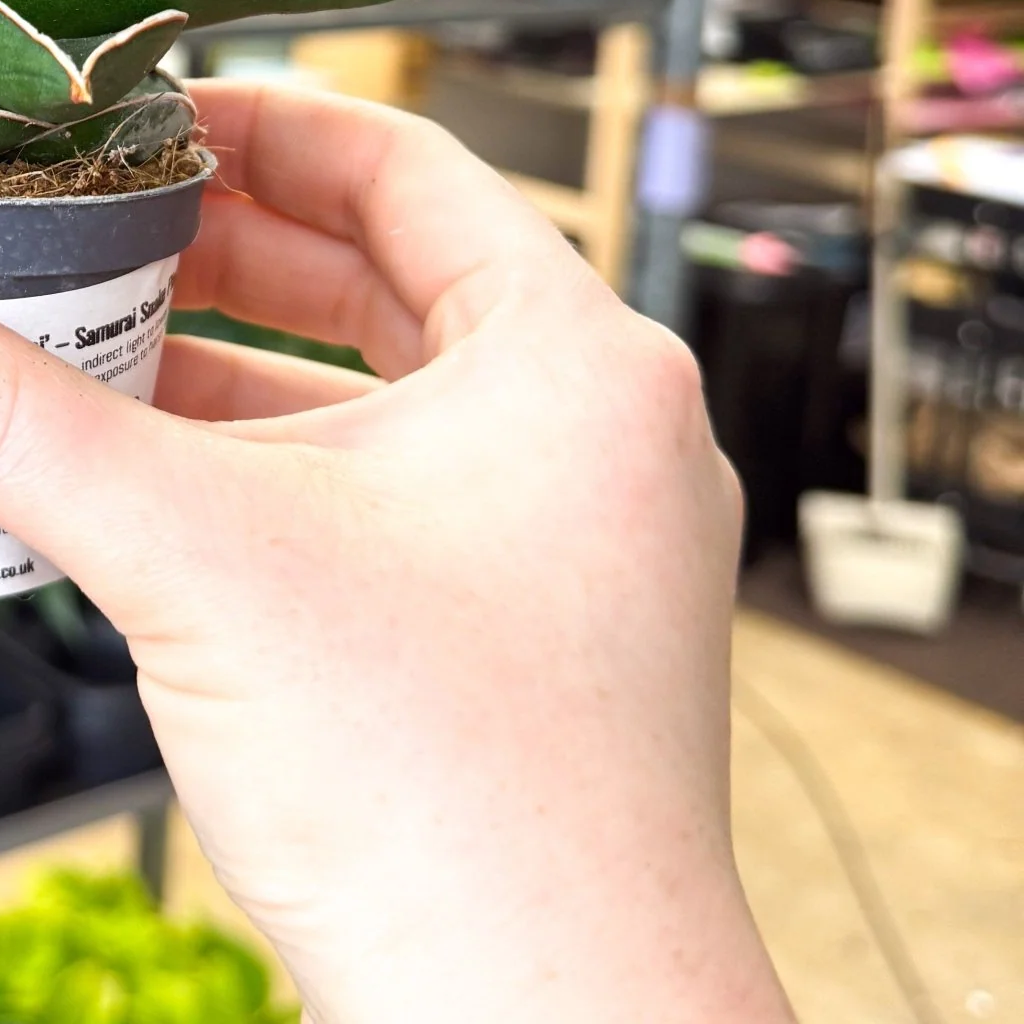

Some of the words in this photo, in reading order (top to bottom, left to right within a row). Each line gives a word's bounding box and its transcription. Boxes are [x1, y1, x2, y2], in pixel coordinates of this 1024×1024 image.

[75, 307, 137, 350] Samurai
[81, 345, 123, 372] indirect
[126, 333, 146, 355] light
